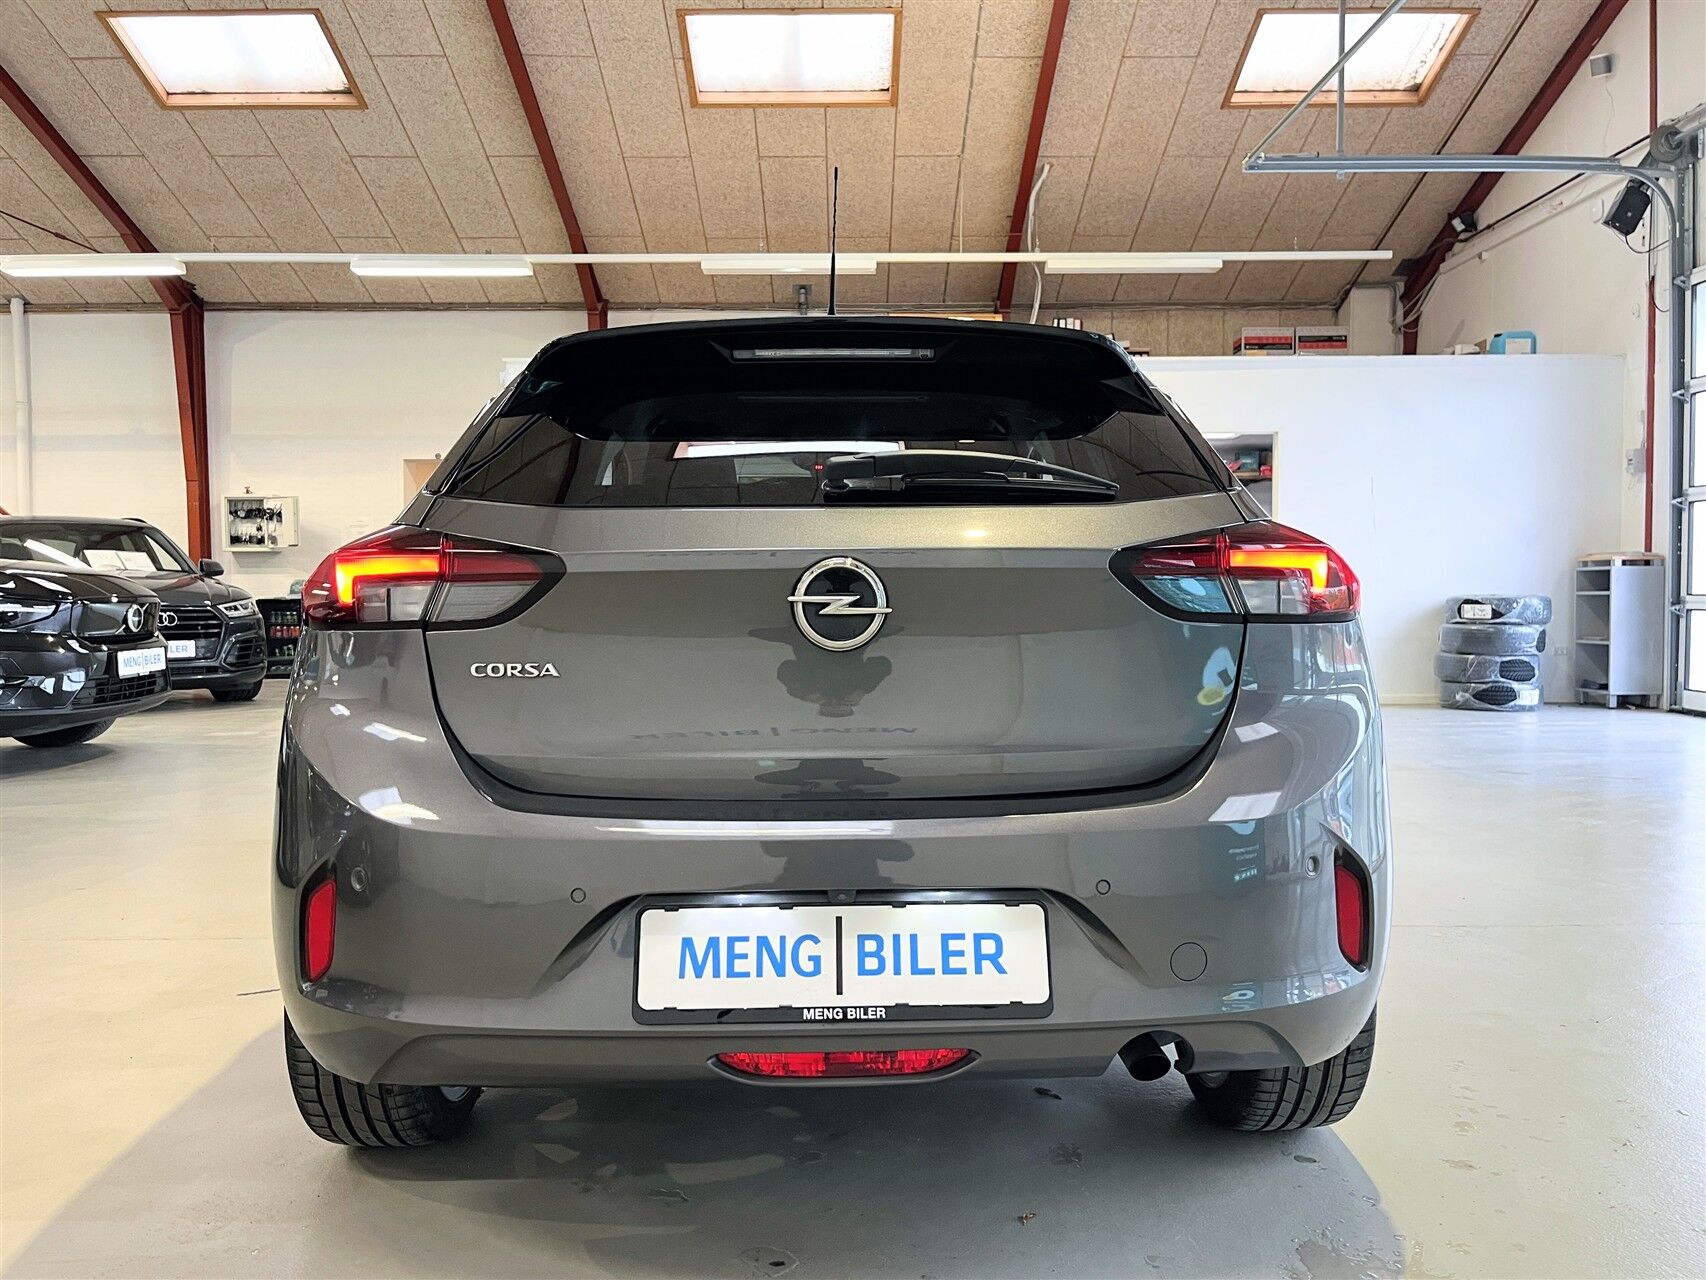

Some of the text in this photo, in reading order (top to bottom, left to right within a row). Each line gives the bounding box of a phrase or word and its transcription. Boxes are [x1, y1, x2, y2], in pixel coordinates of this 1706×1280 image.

[123, 654, 162, 668] MENG BILER
[470, 662, 561, 678] CORSA
[677, 932, 1008, 980] MENG BILER
[803, 1006, 887, 1021] MENG BILER
